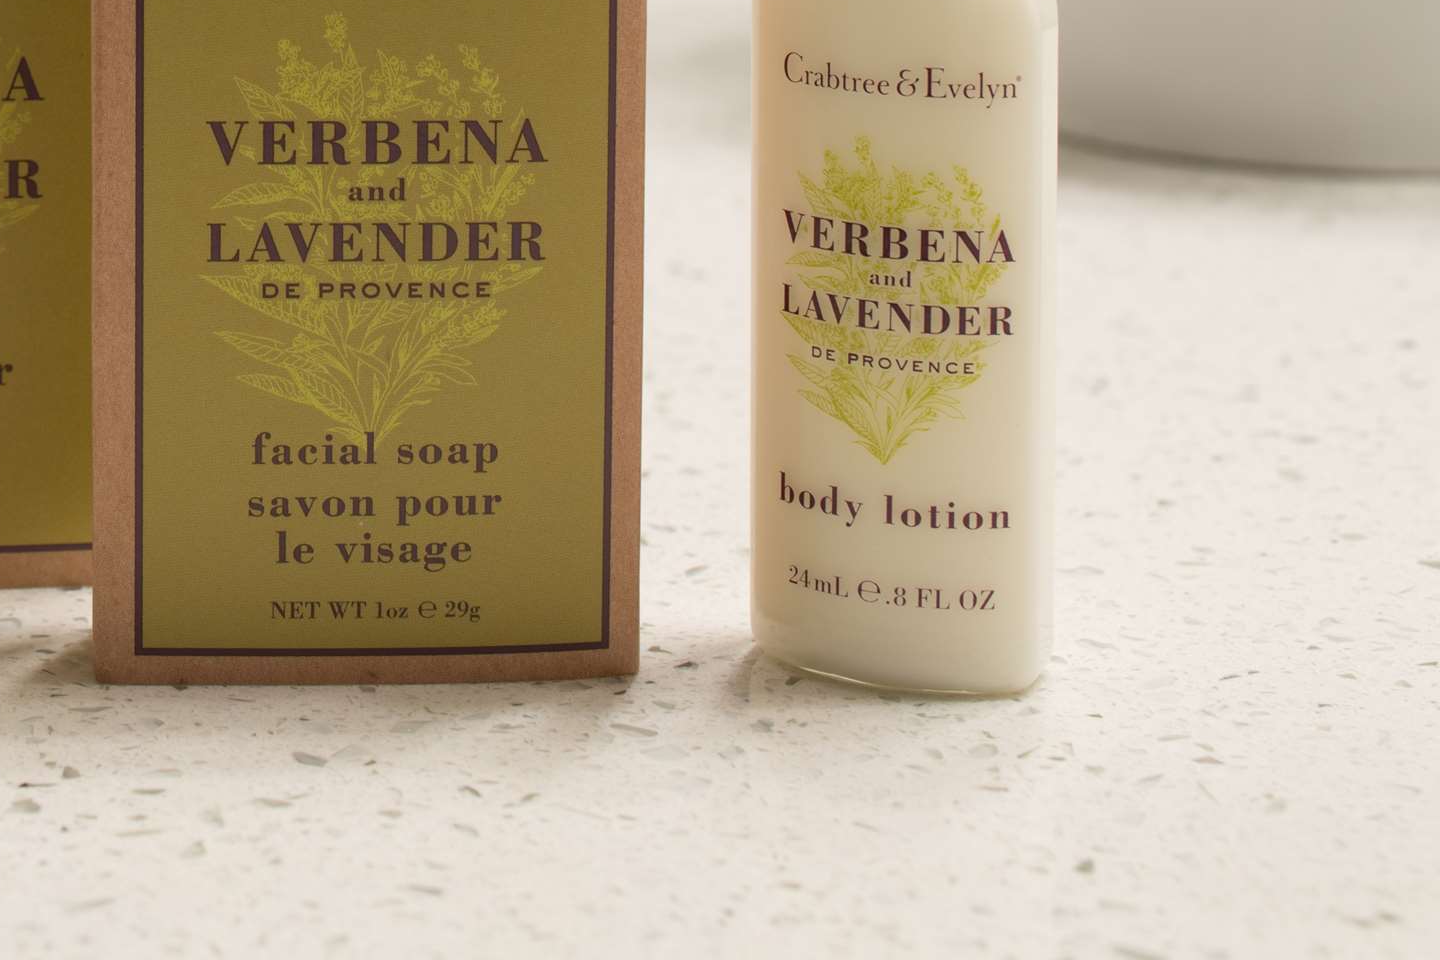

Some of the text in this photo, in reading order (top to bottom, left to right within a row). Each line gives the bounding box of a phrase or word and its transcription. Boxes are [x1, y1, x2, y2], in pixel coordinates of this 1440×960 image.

[207, 118, 547, 165] VERBENA
[349, 178, 405, 201] and
[207, 221, 545, 262] LAVENDER
[784, 209, 1015, 263] VERBENA
[262, 282, 490, 299] DE PROVENCE
[870, 271, 910, 287] and
[782, 284, 1015, 336] LAVENDER
[812, 346, 974, 374] DE PROVENCE
[252, 432, 498, 473] facial soap
[249, 495, 502, 526] savon pour
[780, 471, 1008, 529] body lotion
[276, 531, 471, 572] le visage
[272, 602, 320, 619] NET
[329, 601, 366, 618] WT
[377, 602, 408, 618] 1oz
[445, 601, 480, 621] 29g
[918, 588, 949, 609] FL
[960, 590, 994, 609] OZ
